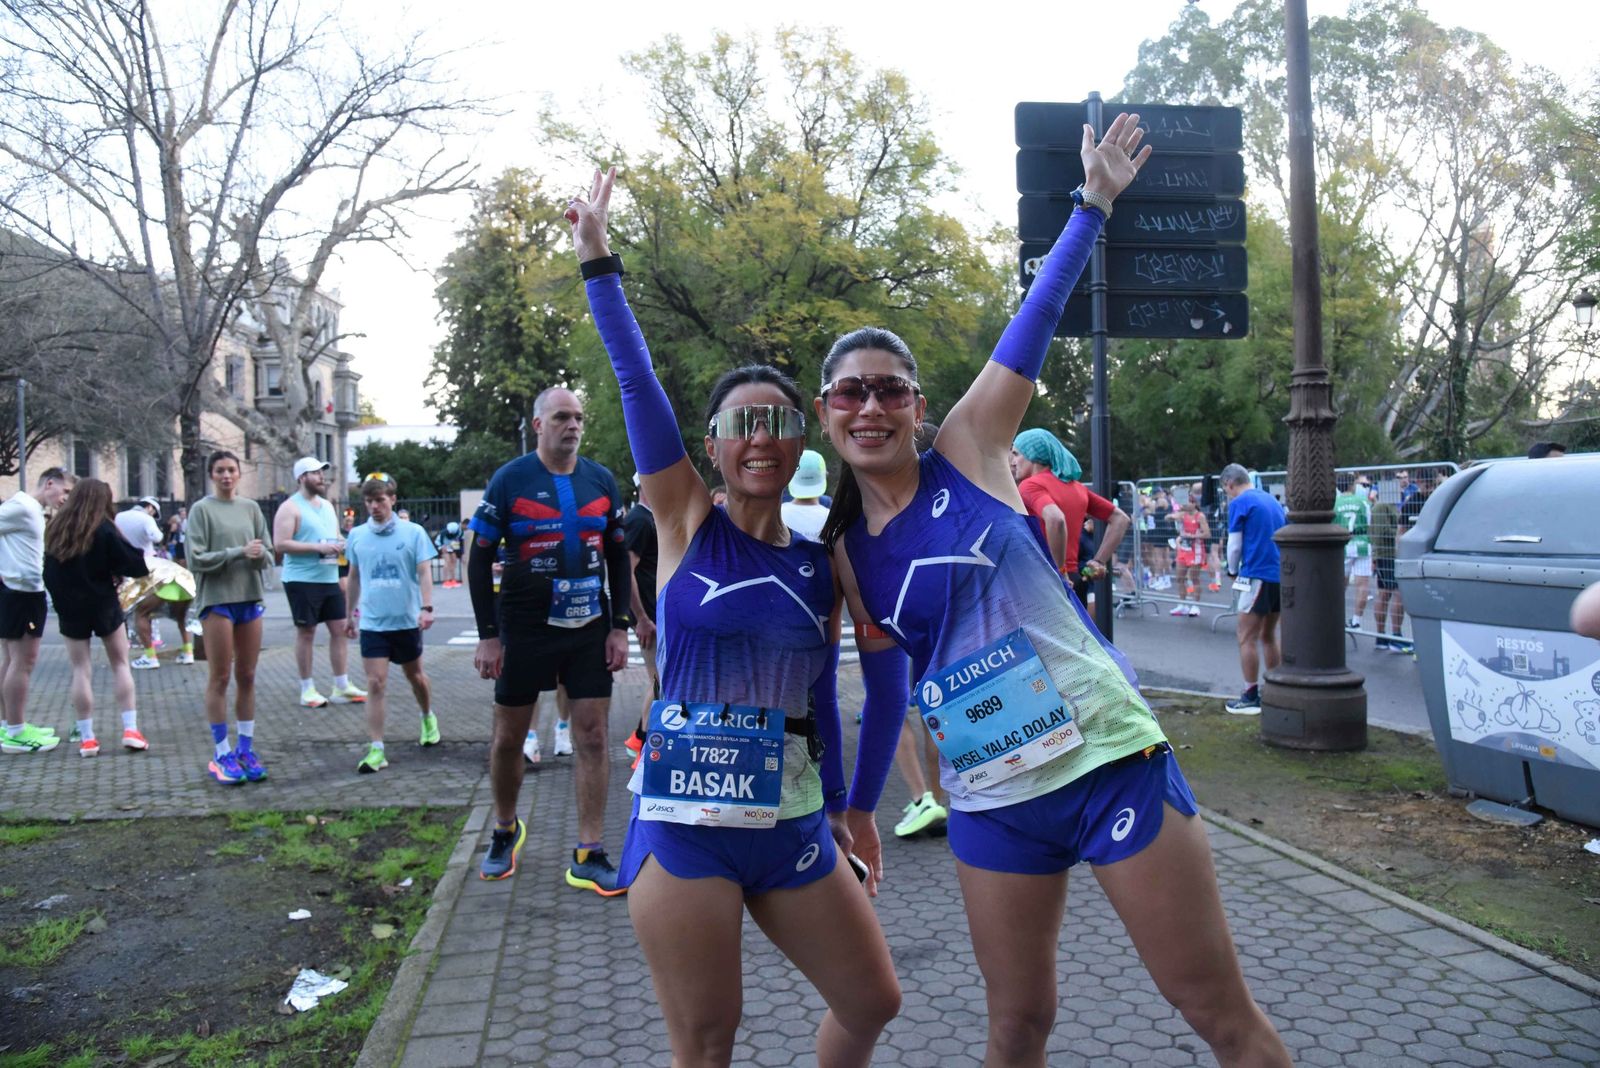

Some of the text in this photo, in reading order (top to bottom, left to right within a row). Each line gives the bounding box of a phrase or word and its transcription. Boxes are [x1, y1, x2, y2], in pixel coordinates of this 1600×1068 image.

[1343, 511, 1356, 532] 7
[1496, 637, 1544, 653] RESTOS
[945, 645, 1016, 692] ZURICH
[696, 711, 768, 730] ZURICH
[965, 695, 1004, 724] 9689
[951, 748, 985, 771] AYSEL
[982, 730, 1023, 758] YALAÇ
[1022, 706, 1068, 739] DOLAY
[690, 746, 739, 764] 17827
[670, 769, 755, 799] BASAK
